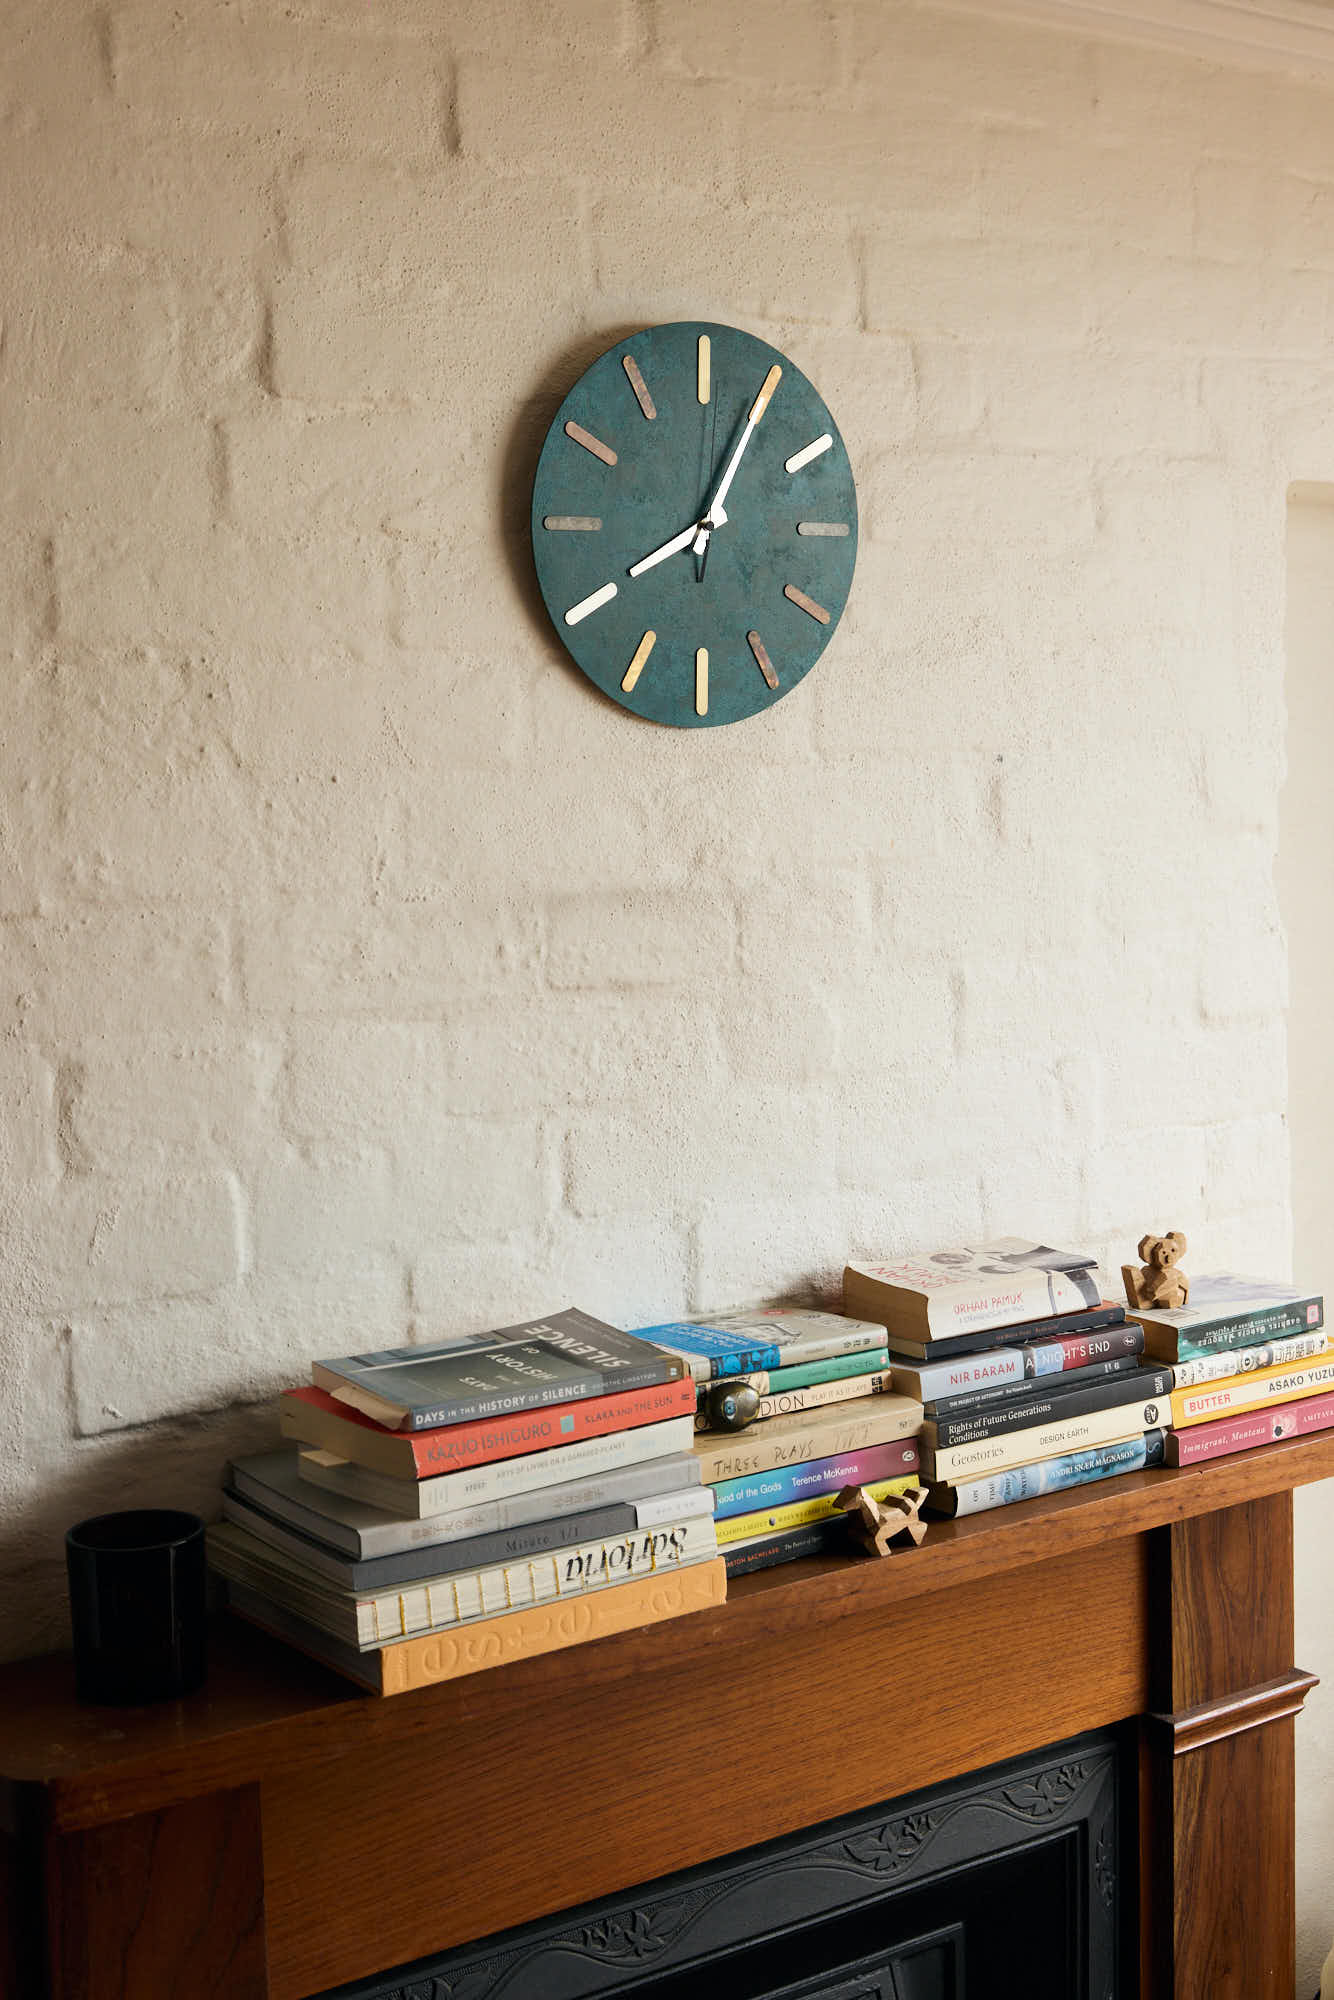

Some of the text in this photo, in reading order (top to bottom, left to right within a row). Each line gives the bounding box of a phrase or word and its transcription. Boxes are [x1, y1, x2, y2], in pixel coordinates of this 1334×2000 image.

[953, 1299, 988, 1315] ORHAN
[991, 1291, 1024, 1309] PAMUK
[524, 1324, 632, 1369] SILENCE
[1025, 1340, 1111, 1370] A NIGHT'S END
[949, 1361, 1016, 1386] NIR BARAM
[1268, 1367, 1334, 1393] ASAKO YUZU
[415, 1410, 446, 1426] DAYS
[460, 1405, 476, 1415] THE
[478, 1395, 526, 1413] HISTORY
[541, 1383, 588, 1402] SILENCE
[633, 1399, 652, 1411] THE
[653, 1394, 674, 1409] SUN
[759, 1394, 805, 1417] DION
[1188, 1393, 1232, 1413] BUTTER
[948, 1403, 1052, 1436] Rights of Future Generations
[426, 1420, 552, 1463] KAZUO ISHIGURO
[948, 1428, 989, 1446] Conditions
[951, 1427, 1089, 1468] Geostories DESIGN EARTH
[1183, 1434, 1229, 1455] Immigrant,
[1231, 1426, 1266, 1443] Montana
[713, 1438, 815, 1478] THREE PLAYS
[791, 1464, 859, 1488] Terence McKenna
[736, 1489, 745, 1501] of
[745, 1487, 759, 1498] the
[760, 1481, 782, 1496] Gods
[565, 1527, 688, 1582] Sartoria
[725, 1558, 746, 1570] ASTON
